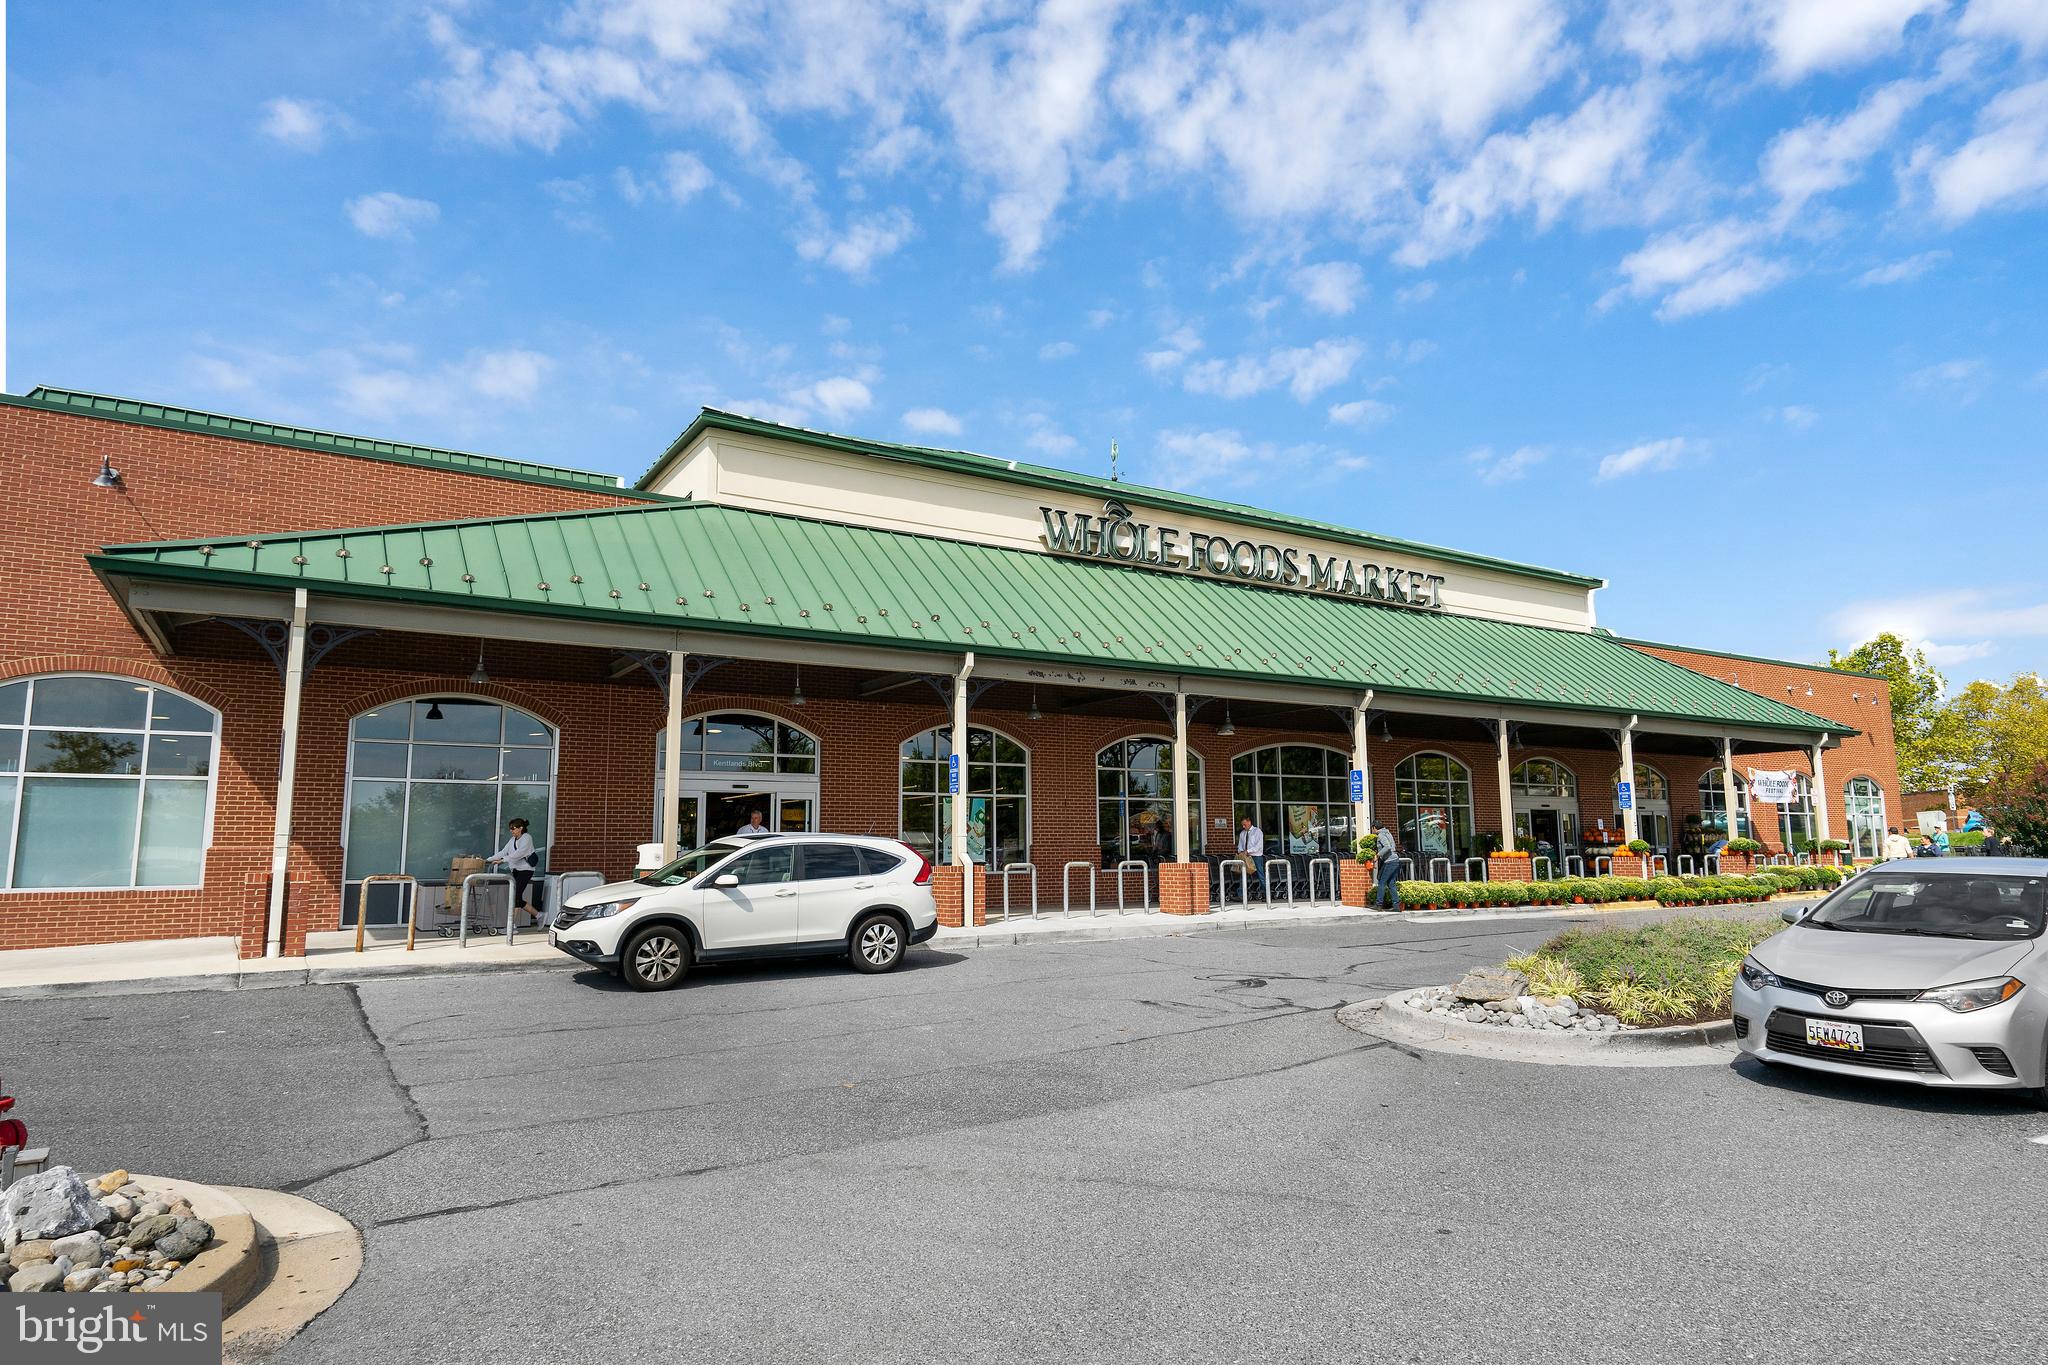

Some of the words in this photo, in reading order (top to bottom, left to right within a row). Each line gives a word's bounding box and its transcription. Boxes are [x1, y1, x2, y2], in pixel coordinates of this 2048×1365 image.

[1038, 505, 1182, 568] WHOLE
[1186, 531, 1300, 586] FOODS
[1305, 553, 1445, 609] MARKET
[713, 760, 747, 768] Kentlands
[748, 760, 763, 768] Blvd
[1808, 1025, 1860, 1044] 5EW4723
